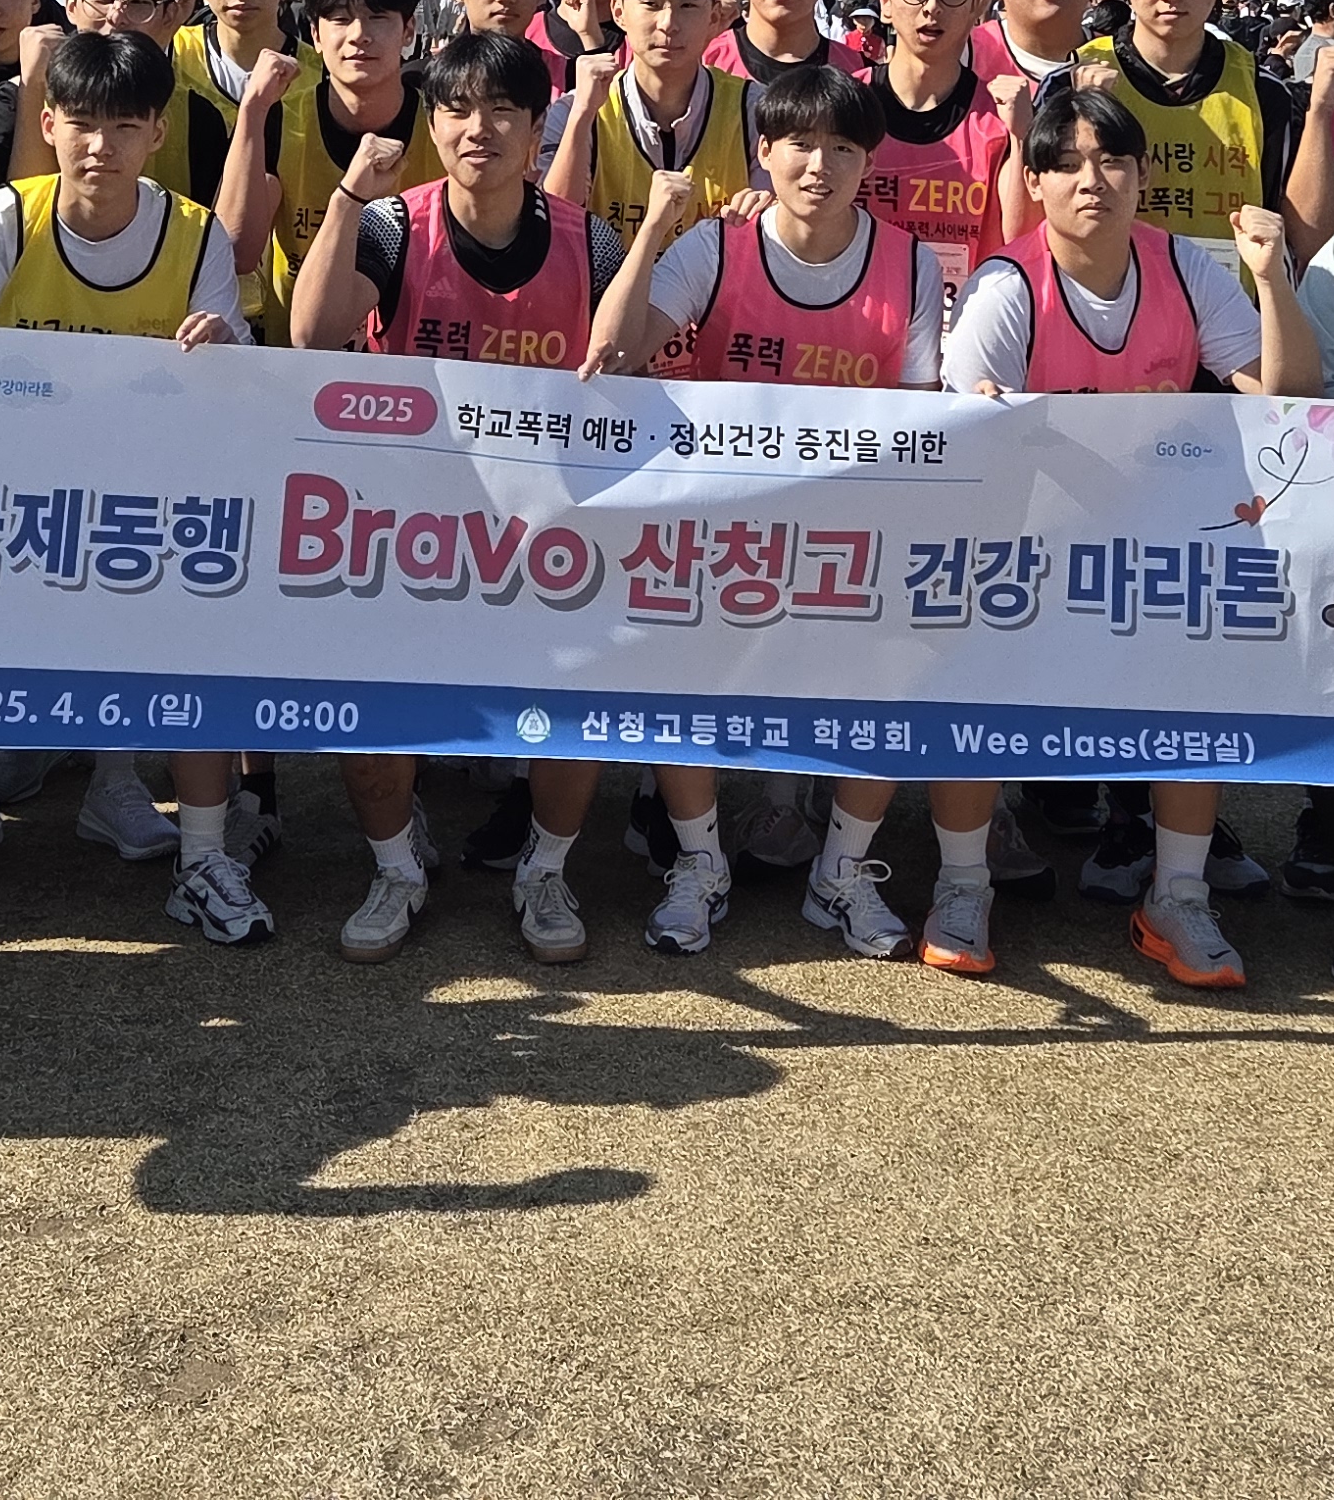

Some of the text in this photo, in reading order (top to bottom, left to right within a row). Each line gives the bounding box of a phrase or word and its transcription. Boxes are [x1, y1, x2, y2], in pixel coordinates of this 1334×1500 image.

[1202, 145, 1249, 176] 시작
[907, 177, 989, 216] ZERO
[413, 318, 568, 365] 폭력 ZERO
[726, 332, 880, 388] 폭력 ZERO
[337, 393, 414, 423] 2025
[456, 402, 573, 449] 학교폭력
[581, 416, 638, 454] 예방
[669, 421, 786, 461] 정신건강
[794, 426, 882, 463] 증진을
[890, 429, 948, 465] 위한
[1155, 441, 1213, 458] Go Go~
[276, 472, 591, 598] Bravo
[618, 518, 876, 618] 산청고
[902, 534, 1045, 622] 건강
[1065, 536, 1289, 632] 마라톤
[49, 692, 84, 725] 4.
[97, 693, 131, 726] 6.
[147, 693, 203, 730] (일)
[254, 699, 360, 733] 08:00
[580, 710, 1256, 765] 산청고등학교 학생회, Wee class(상담실)
